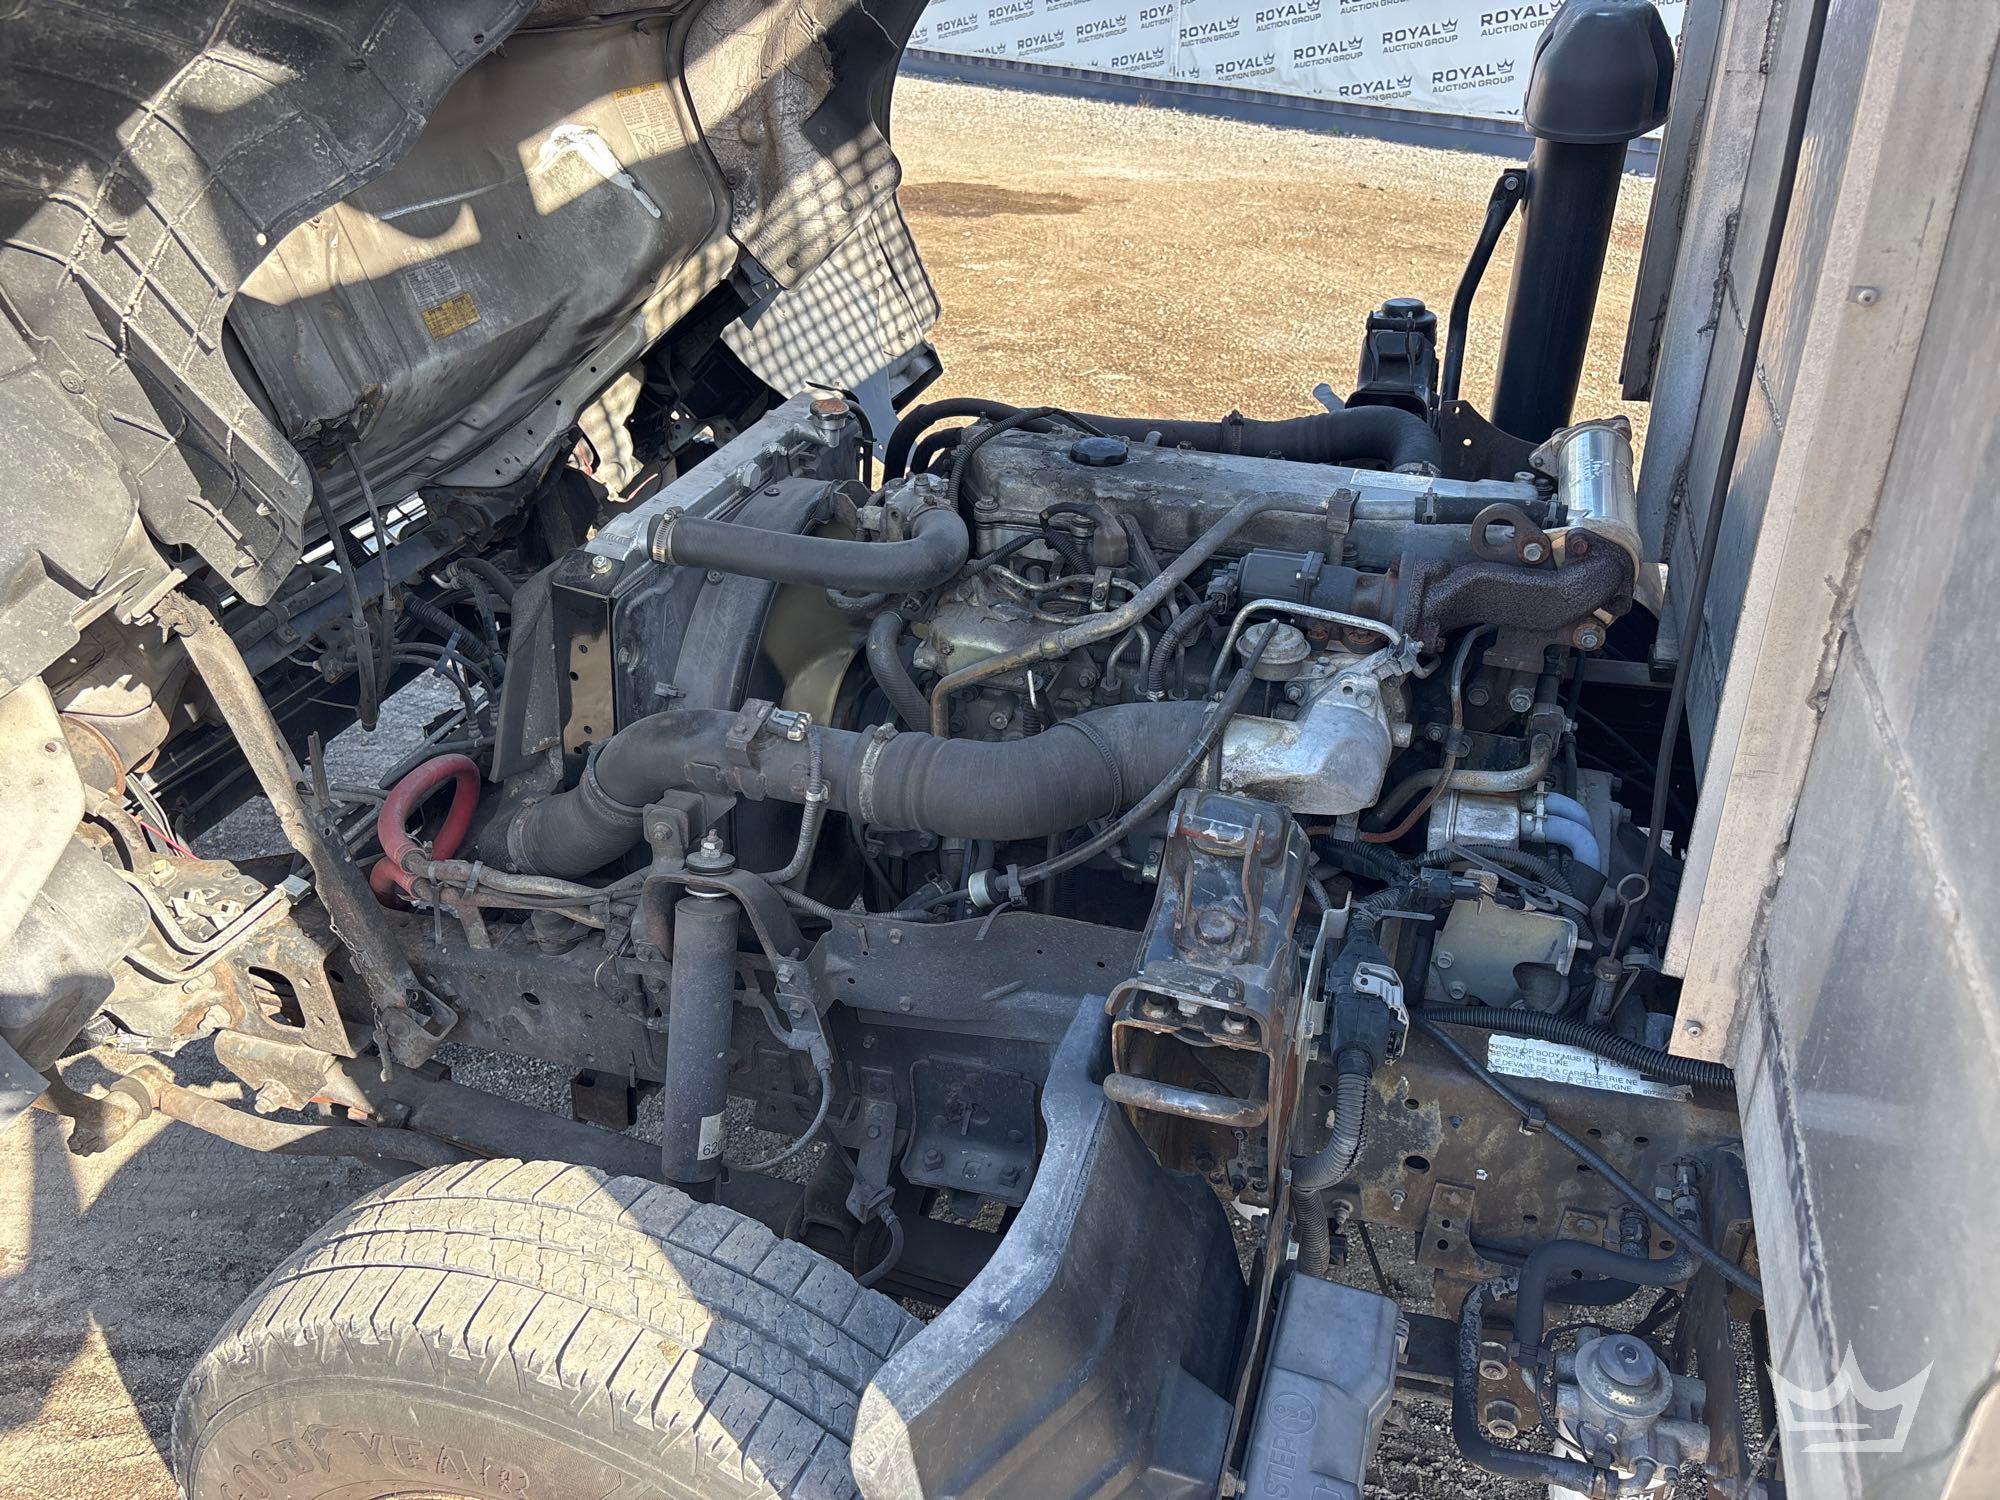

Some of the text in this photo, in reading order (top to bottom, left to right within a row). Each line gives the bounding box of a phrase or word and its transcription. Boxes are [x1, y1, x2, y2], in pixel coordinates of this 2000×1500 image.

[988, 2, 1024, 19] ROYAL
[1047, 1, 1072, 11] AUCTION
[1139, 3, 1174, 21] ROYA
[1255, 3, 1306, 24] ROYAL
[1340, 2, 1379, 15] AUCTION
[937, 16, 969, 32] ROYAL
[990, 16, 1014, 26] AUCTION
[1256, 12, 1321, 32] AUCTION GROUP
[1481, 4, 1549, 27] ROYAL
[1076, 18, 1116, 36] ROYAL
[1077, 27, 1127, 43] AUCTION GROUP
[1179, 21, 1227, 40] ROYAL
[1382, 23, 1441, 44] ROYAL
[1481, 22, 1528, 37] AUCTION
[1017, 33, 1054, 50] ROYAL
[1180, 30, 1240, 48] AUCTION GROUP
[1382, 34, 1458, 54] AUCTION GROUP
[1111, 50, 1153, 68] ROYAL
[1293, 40, 1348, 60] ROYAL
[1141, 60, 1165, 70] GROUP
[1215, 56, 1263, 75] ROYAL
[1293, 51, 1363, 69] AUCTION GROUP
[1250, 66, 1276, 78] GROUP
[1432, 63, 1496, 84] ROYAL
[1339, 79, 1395, 97] ROYAL
[1432, 75, 1515, 94] AUCTION GROUP
[1379, 90, 1412, 101] GROUP
[1491, 1050, 1569, 1067] BEYOND THIS LINE
[1536, 1050, 1560, 1058] BODY
[1562, 1054, 1586, 1062] MUST
[1502, 1060, 1534, 1070] DEVANT
[1625, 1078, 1638, 1086] NE
